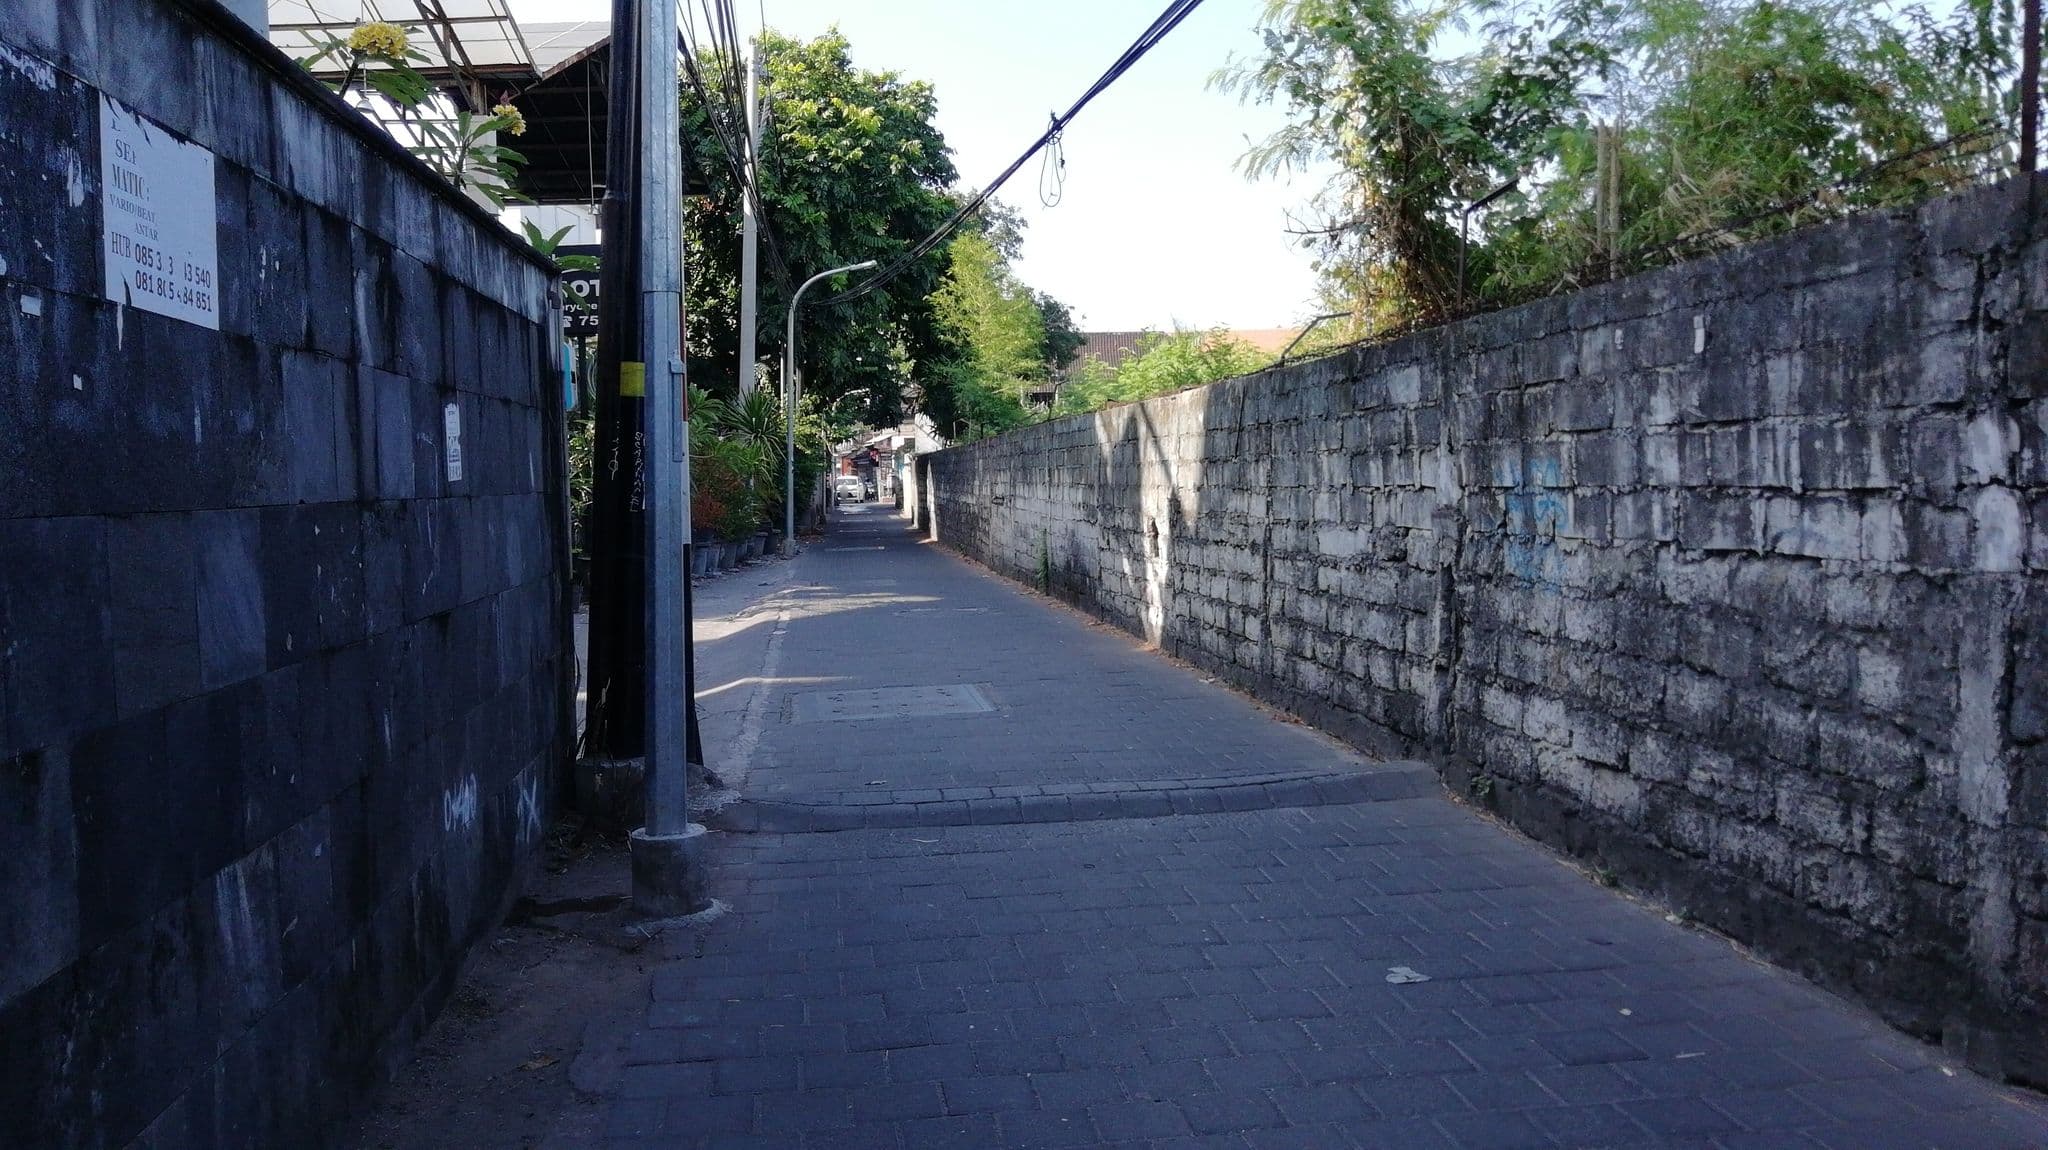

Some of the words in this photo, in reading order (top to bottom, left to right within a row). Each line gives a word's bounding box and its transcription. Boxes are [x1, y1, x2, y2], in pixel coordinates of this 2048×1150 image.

[111, 231, 131, 258] HUB
[135, 243, 154, 268] 085
[195, 266, 211, 289] 540
[135, 270, 154, 294] 081
[196, 291, 212, 313] 851
